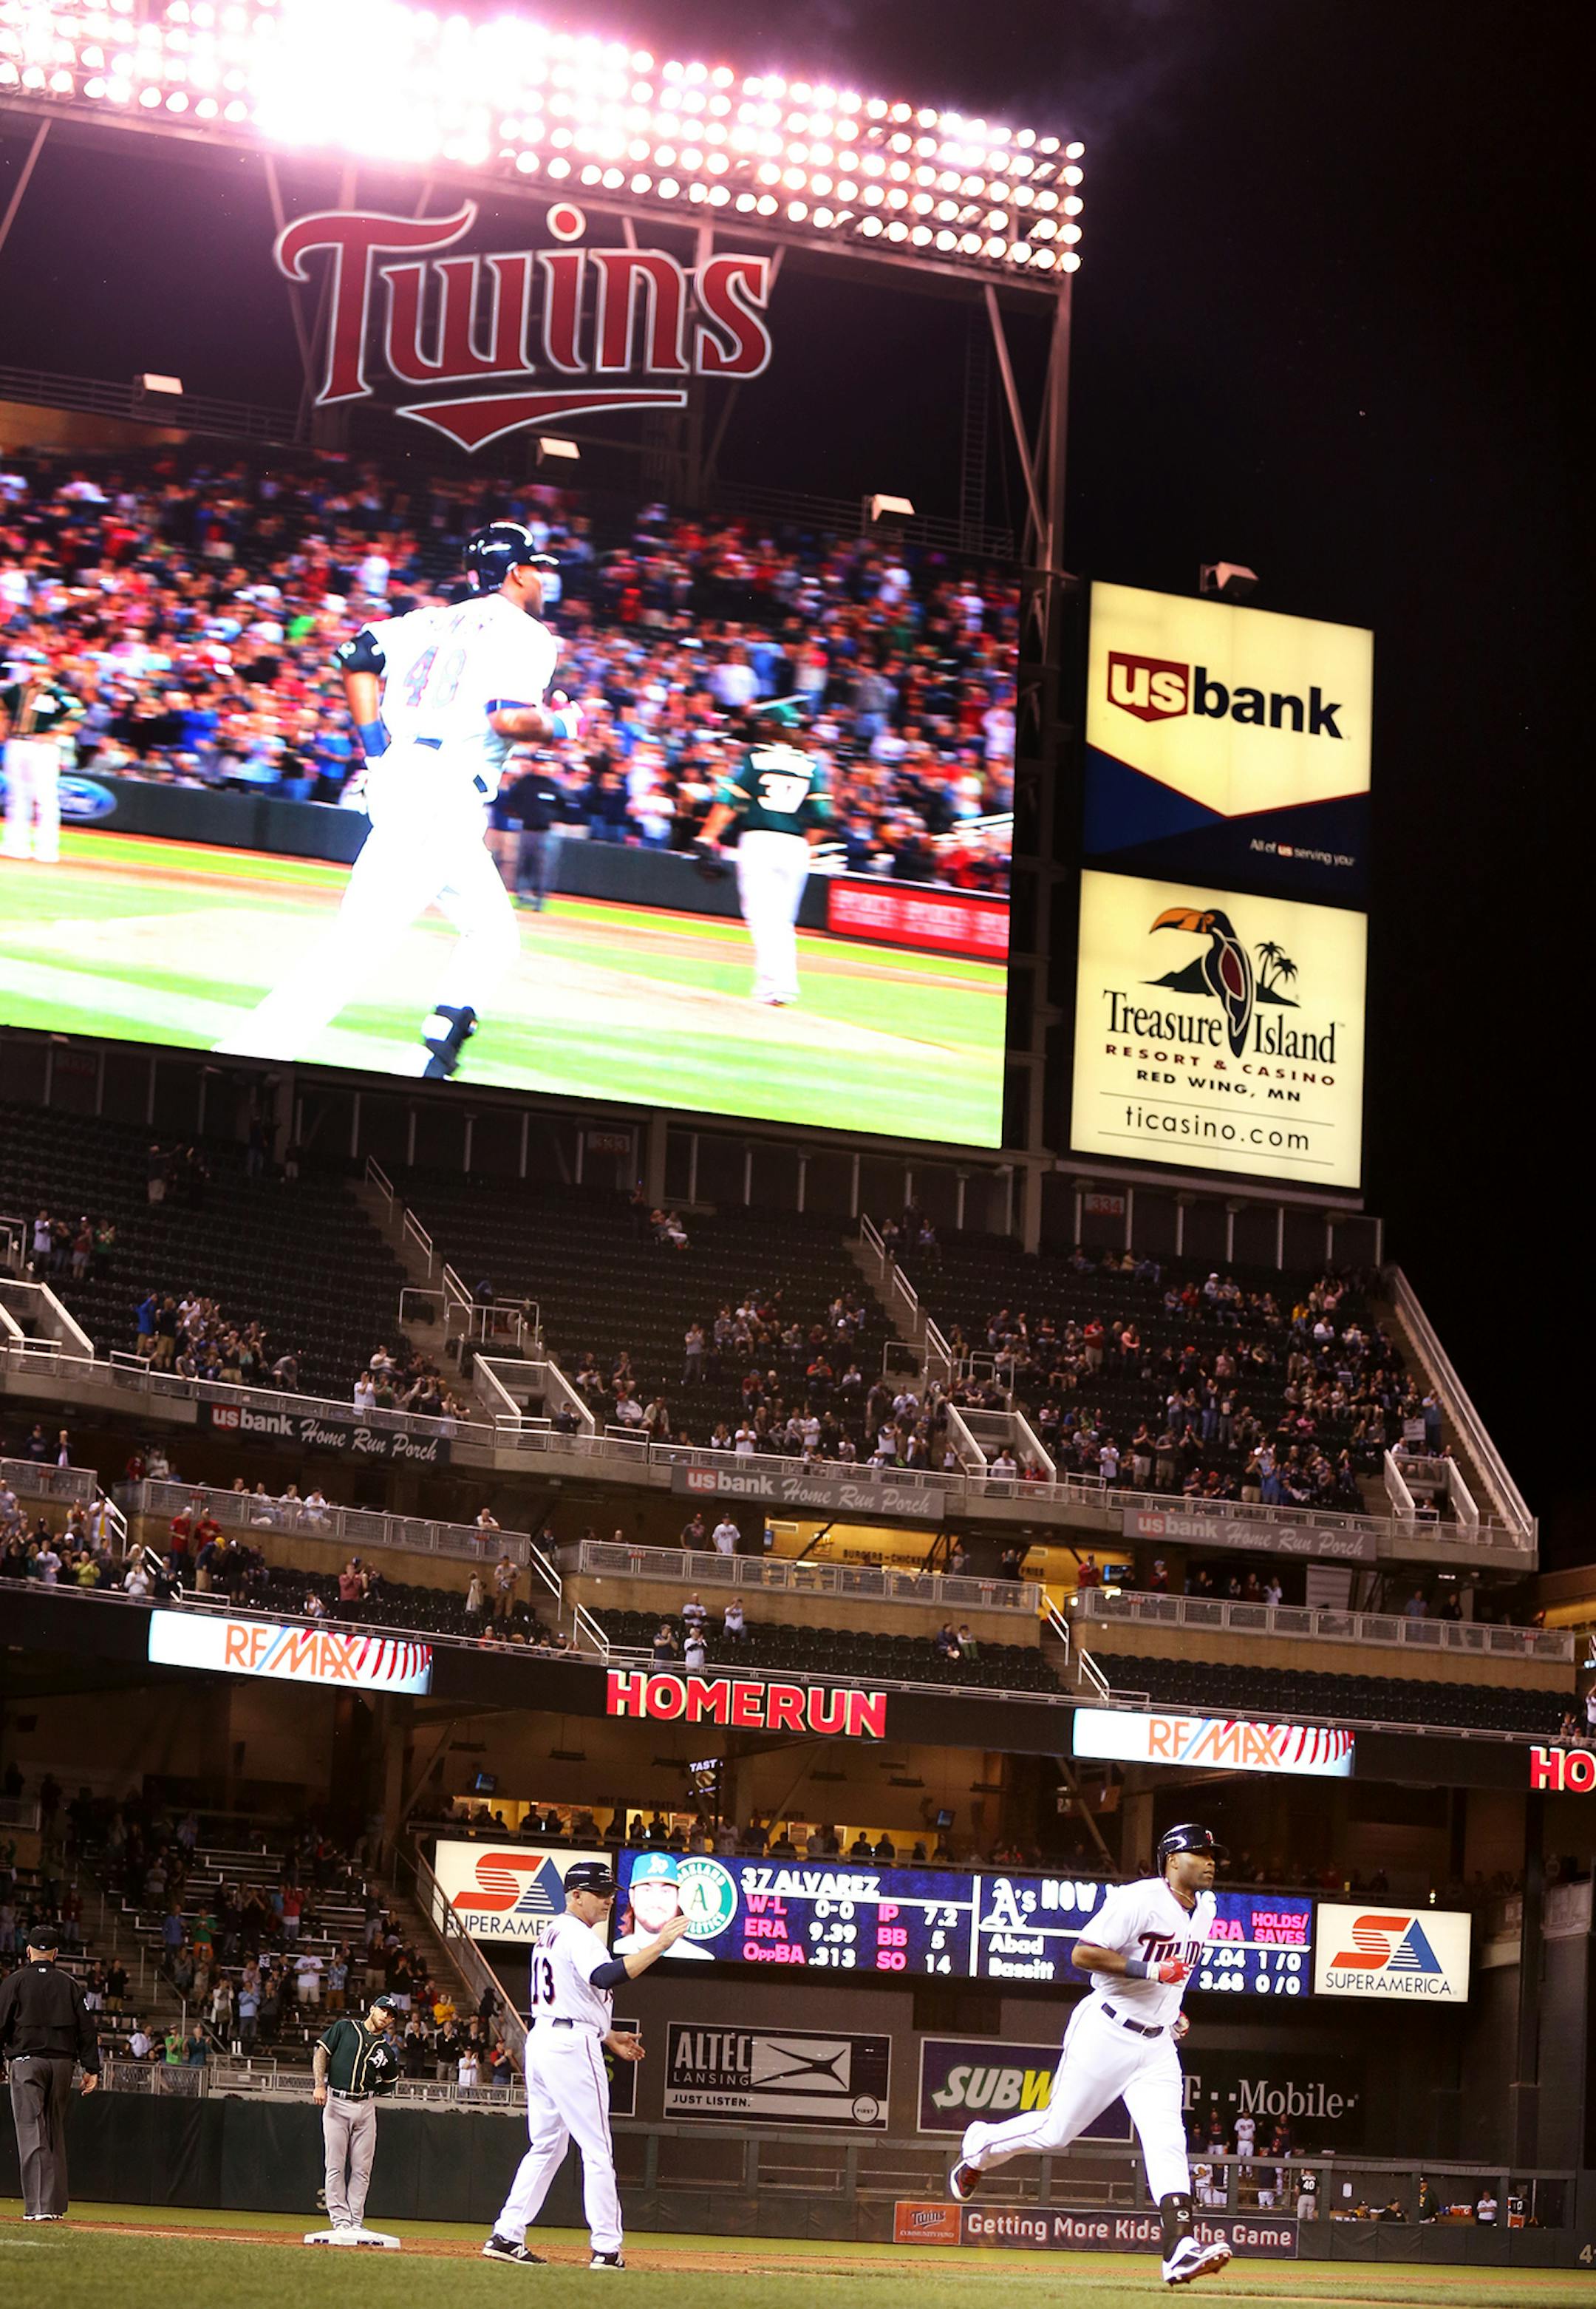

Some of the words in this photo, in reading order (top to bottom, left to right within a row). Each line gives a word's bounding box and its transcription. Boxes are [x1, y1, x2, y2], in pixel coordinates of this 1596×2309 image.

[274, 200, 773, 406] Twins
[1249, 838, 1264, 851] All
[1264, 841, 1277, 853] of
[1278, 843, 1292, 857] us
[1294, 847, 1331, 866] serving
[1103, 989, 1222, 1047] Treasure
[1252, 1013, 1337, 1064] Island
[1105, 1044, 1201, 1067] RESORT
[1213, 1058, 1227, 1071] &
[1242, 1064, 1335, 1087] CASINO
[1136, 1069, 1176, 1085] RED
[1188, 1075, 1255, 1098] WING,
[1267, 1087, 1300, 1102] MN
[1125, 1105, 1309, 1151] ticasino.com
[299, 1418, 346, 1447] Home
[352, 1426, 386, 1453] Run
[391, 1432, 438, 1461] Porch
[780, 1477, 832, 1505] Home
[838, 1484, 875, 1509] Run
[881, 1487, 931, 1514] Porch
[1224, 1521, 1272, 1548] Home
[1278, 1527, 1312, 1552] Run
[1317, 1531, 1364, 1557] Porch
[606, 1668, 887, 1738] HOMERUN
[1530, 1745, 1596, 1793] HO
[740, 1867, 774, 1889] 37
[774, 1869, 881, 1897] ALVAREZ
[1040, 1879, 1098, 1913] NOW
[745, 1894, 788, 1915] W-L
[815, 1899, 855, 1920] 0-0
[878, 1903, 899, 1922] IP
[924, 1907, 958, 1928] 7.2
[1207, 1919, 1245, 1942] RA
[1251, 1912, 1309, 1929] HOLDS/
[743, 1917, 788, 1939] ERA
[808, 1922, 857, 1944] 9.39
[877, 1927, 908, 1947] BB
[931, 1930, 946, 1950] 5
[988, 1933, 1045, 1956] Abad
[1201, 1947, 1247, 1968] 7.04
[1253, 1928, 1306, 1945] SAVES
[808, 1946, 856, 1968] .313
[876, 1951, 907, 1971] SO
[924, 1953, 952, 1974] 14
[988, 1956, 1056, 1980] Bassitt
[1198, 1970, 1245, 1991] 3.68
[531, 1956, 556, 2006] 13
[1326, 1972, 1452, 1995] SUPERAMERICA
[674, 2031, 751, 2072] ALTEC
[673, 2071, 749, 2086] LANSING
[672, 2093, 703, 2104] JUST
[706, 2095, 751, 2107] LISTEN.
[1303, 2180, 1315, 2191] 40
[910, 2209, 947, 2228] Twins
[967, 2213, 1047, 2241] Getting
[1054, 2217, 1109, 2238] More
[1115, 2219, 1162, 2241] Kids
[1193, 2222, 1226, 2243] the
[1232, 2224, 1292, 2246] Game
